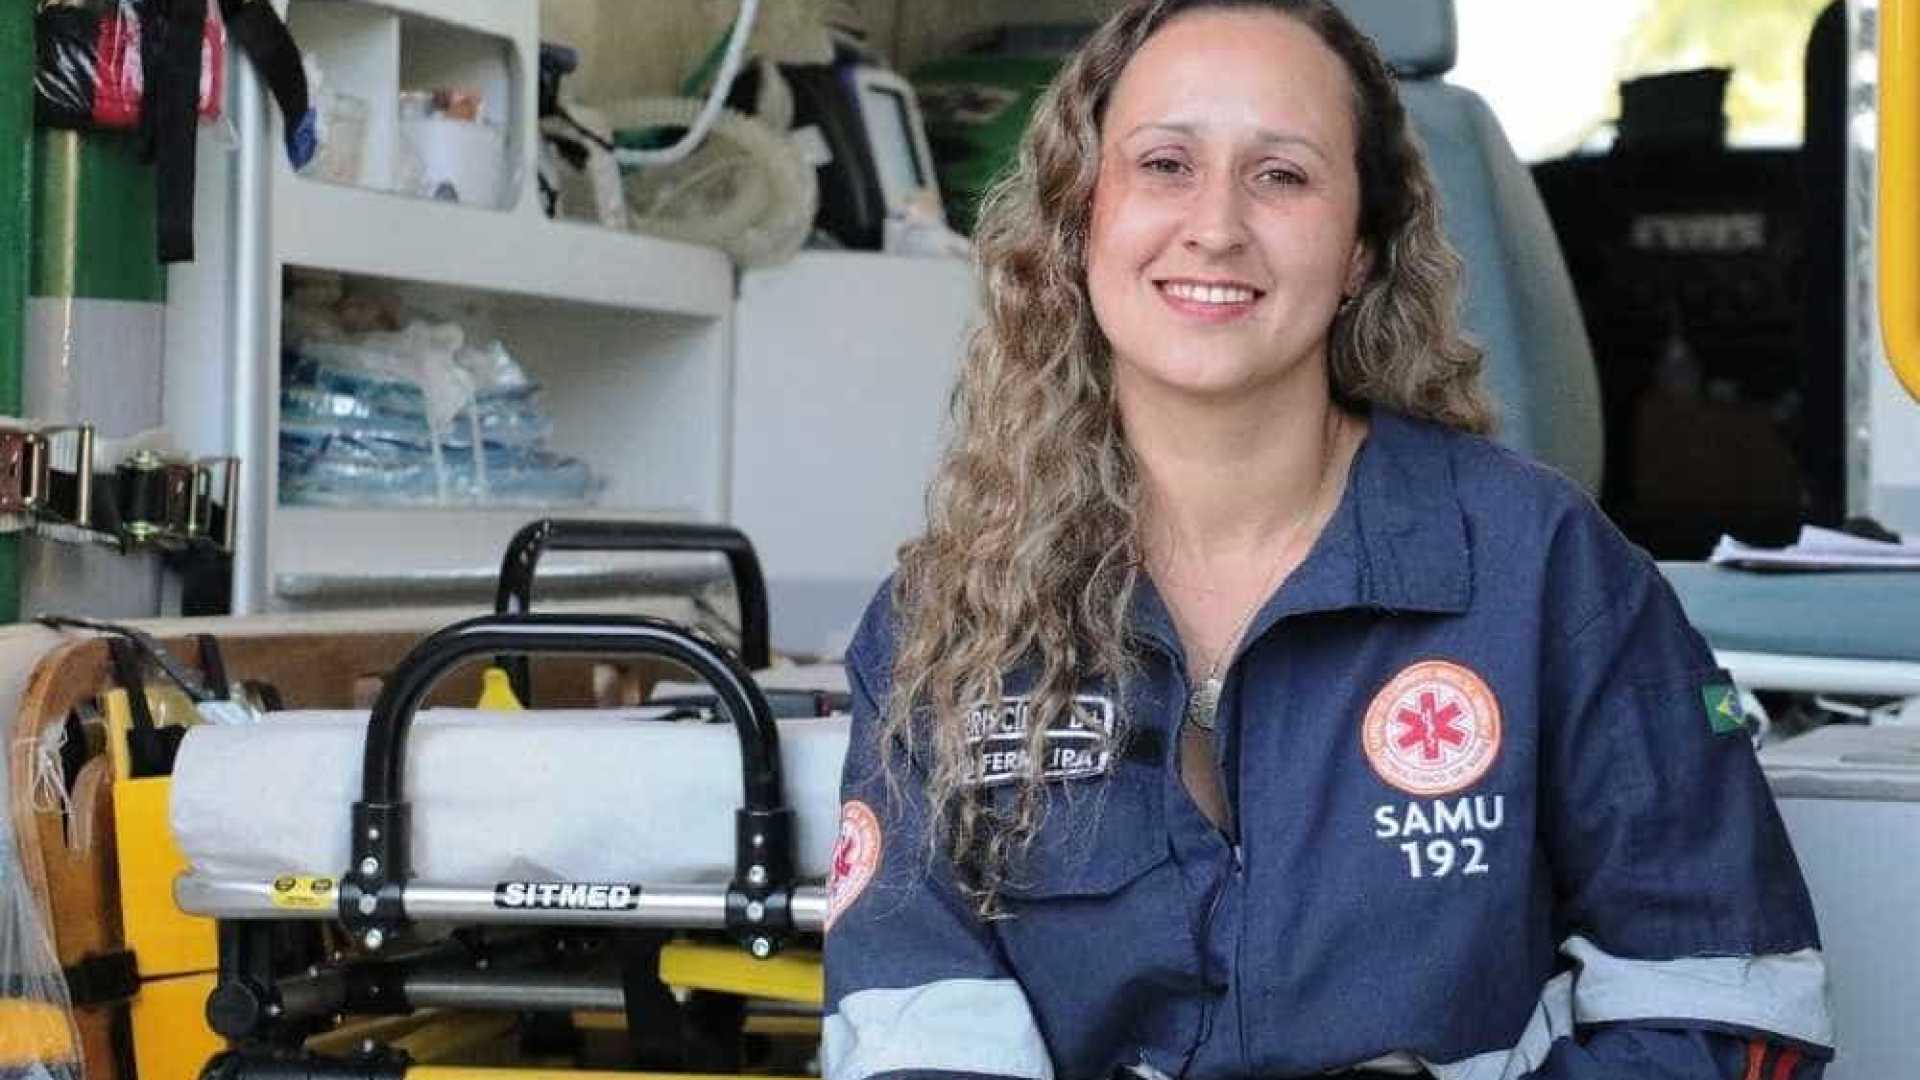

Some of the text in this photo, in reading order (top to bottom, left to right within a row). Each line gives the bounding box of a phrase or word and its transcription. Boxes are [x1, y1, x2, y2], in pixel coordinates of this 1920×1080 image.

[1374, 796, 1504, 838] SAMU
[1400, 838, 1488, 879] 192
[504, 882, 632, 909] SITMED
